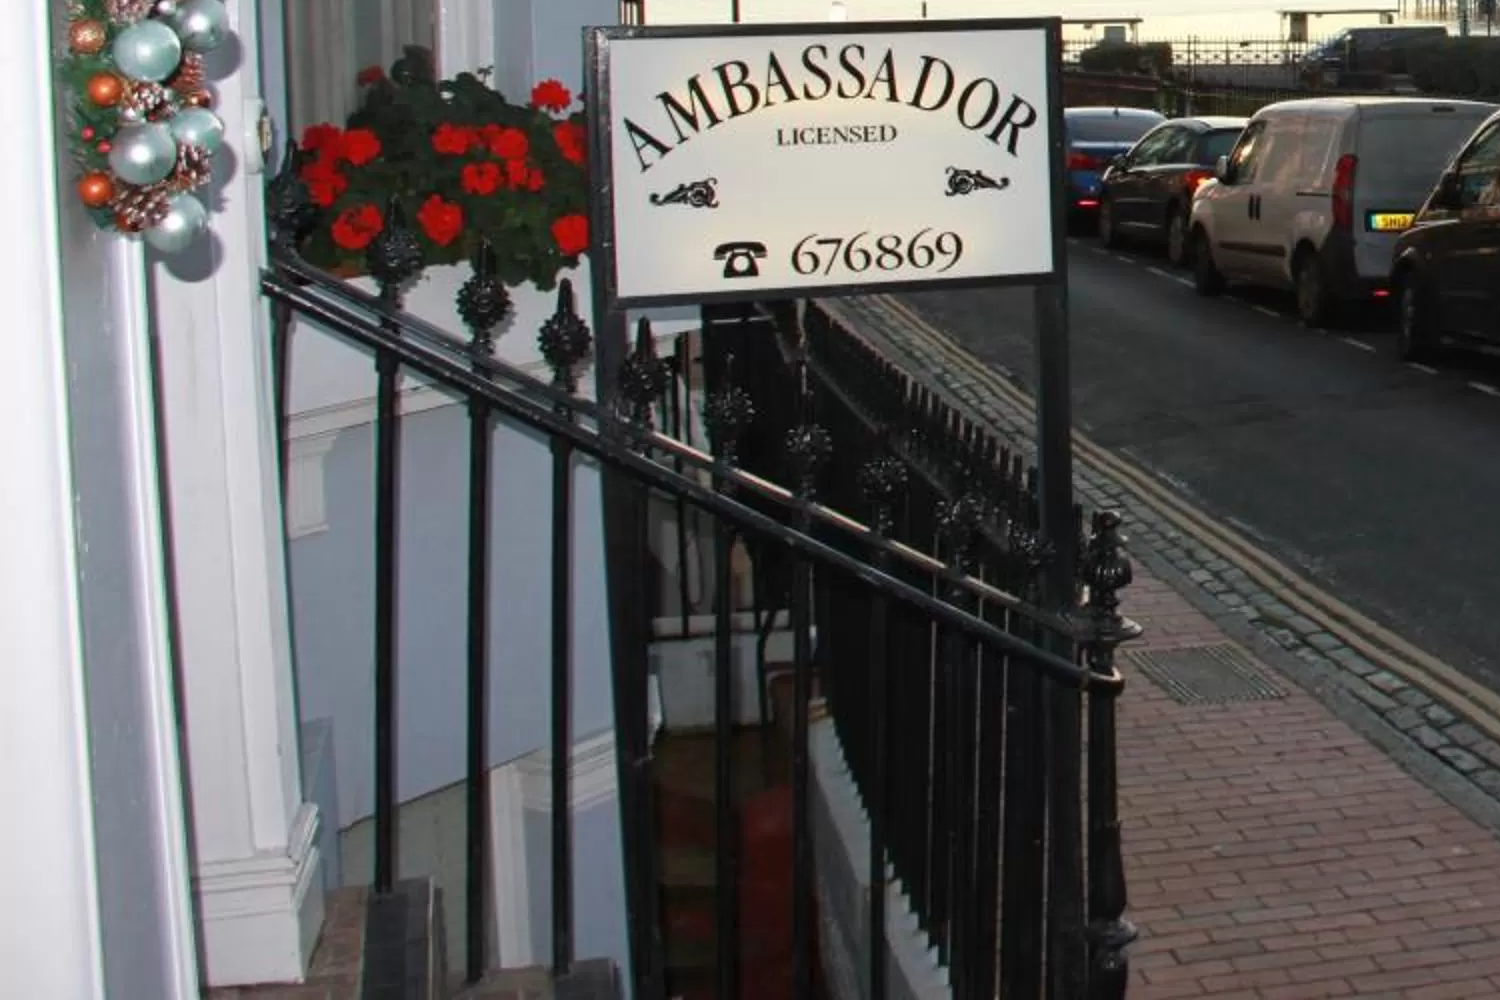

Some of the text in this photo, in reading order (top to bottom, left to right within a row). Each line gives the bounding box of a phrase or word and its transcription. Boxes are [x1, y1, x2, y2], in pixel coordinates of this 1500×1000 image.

[622, 43, 1038, 173] AMBASSADOR
[776, 123, 898, 147] LICENSED
[791, 227, 963, 277] 676869
